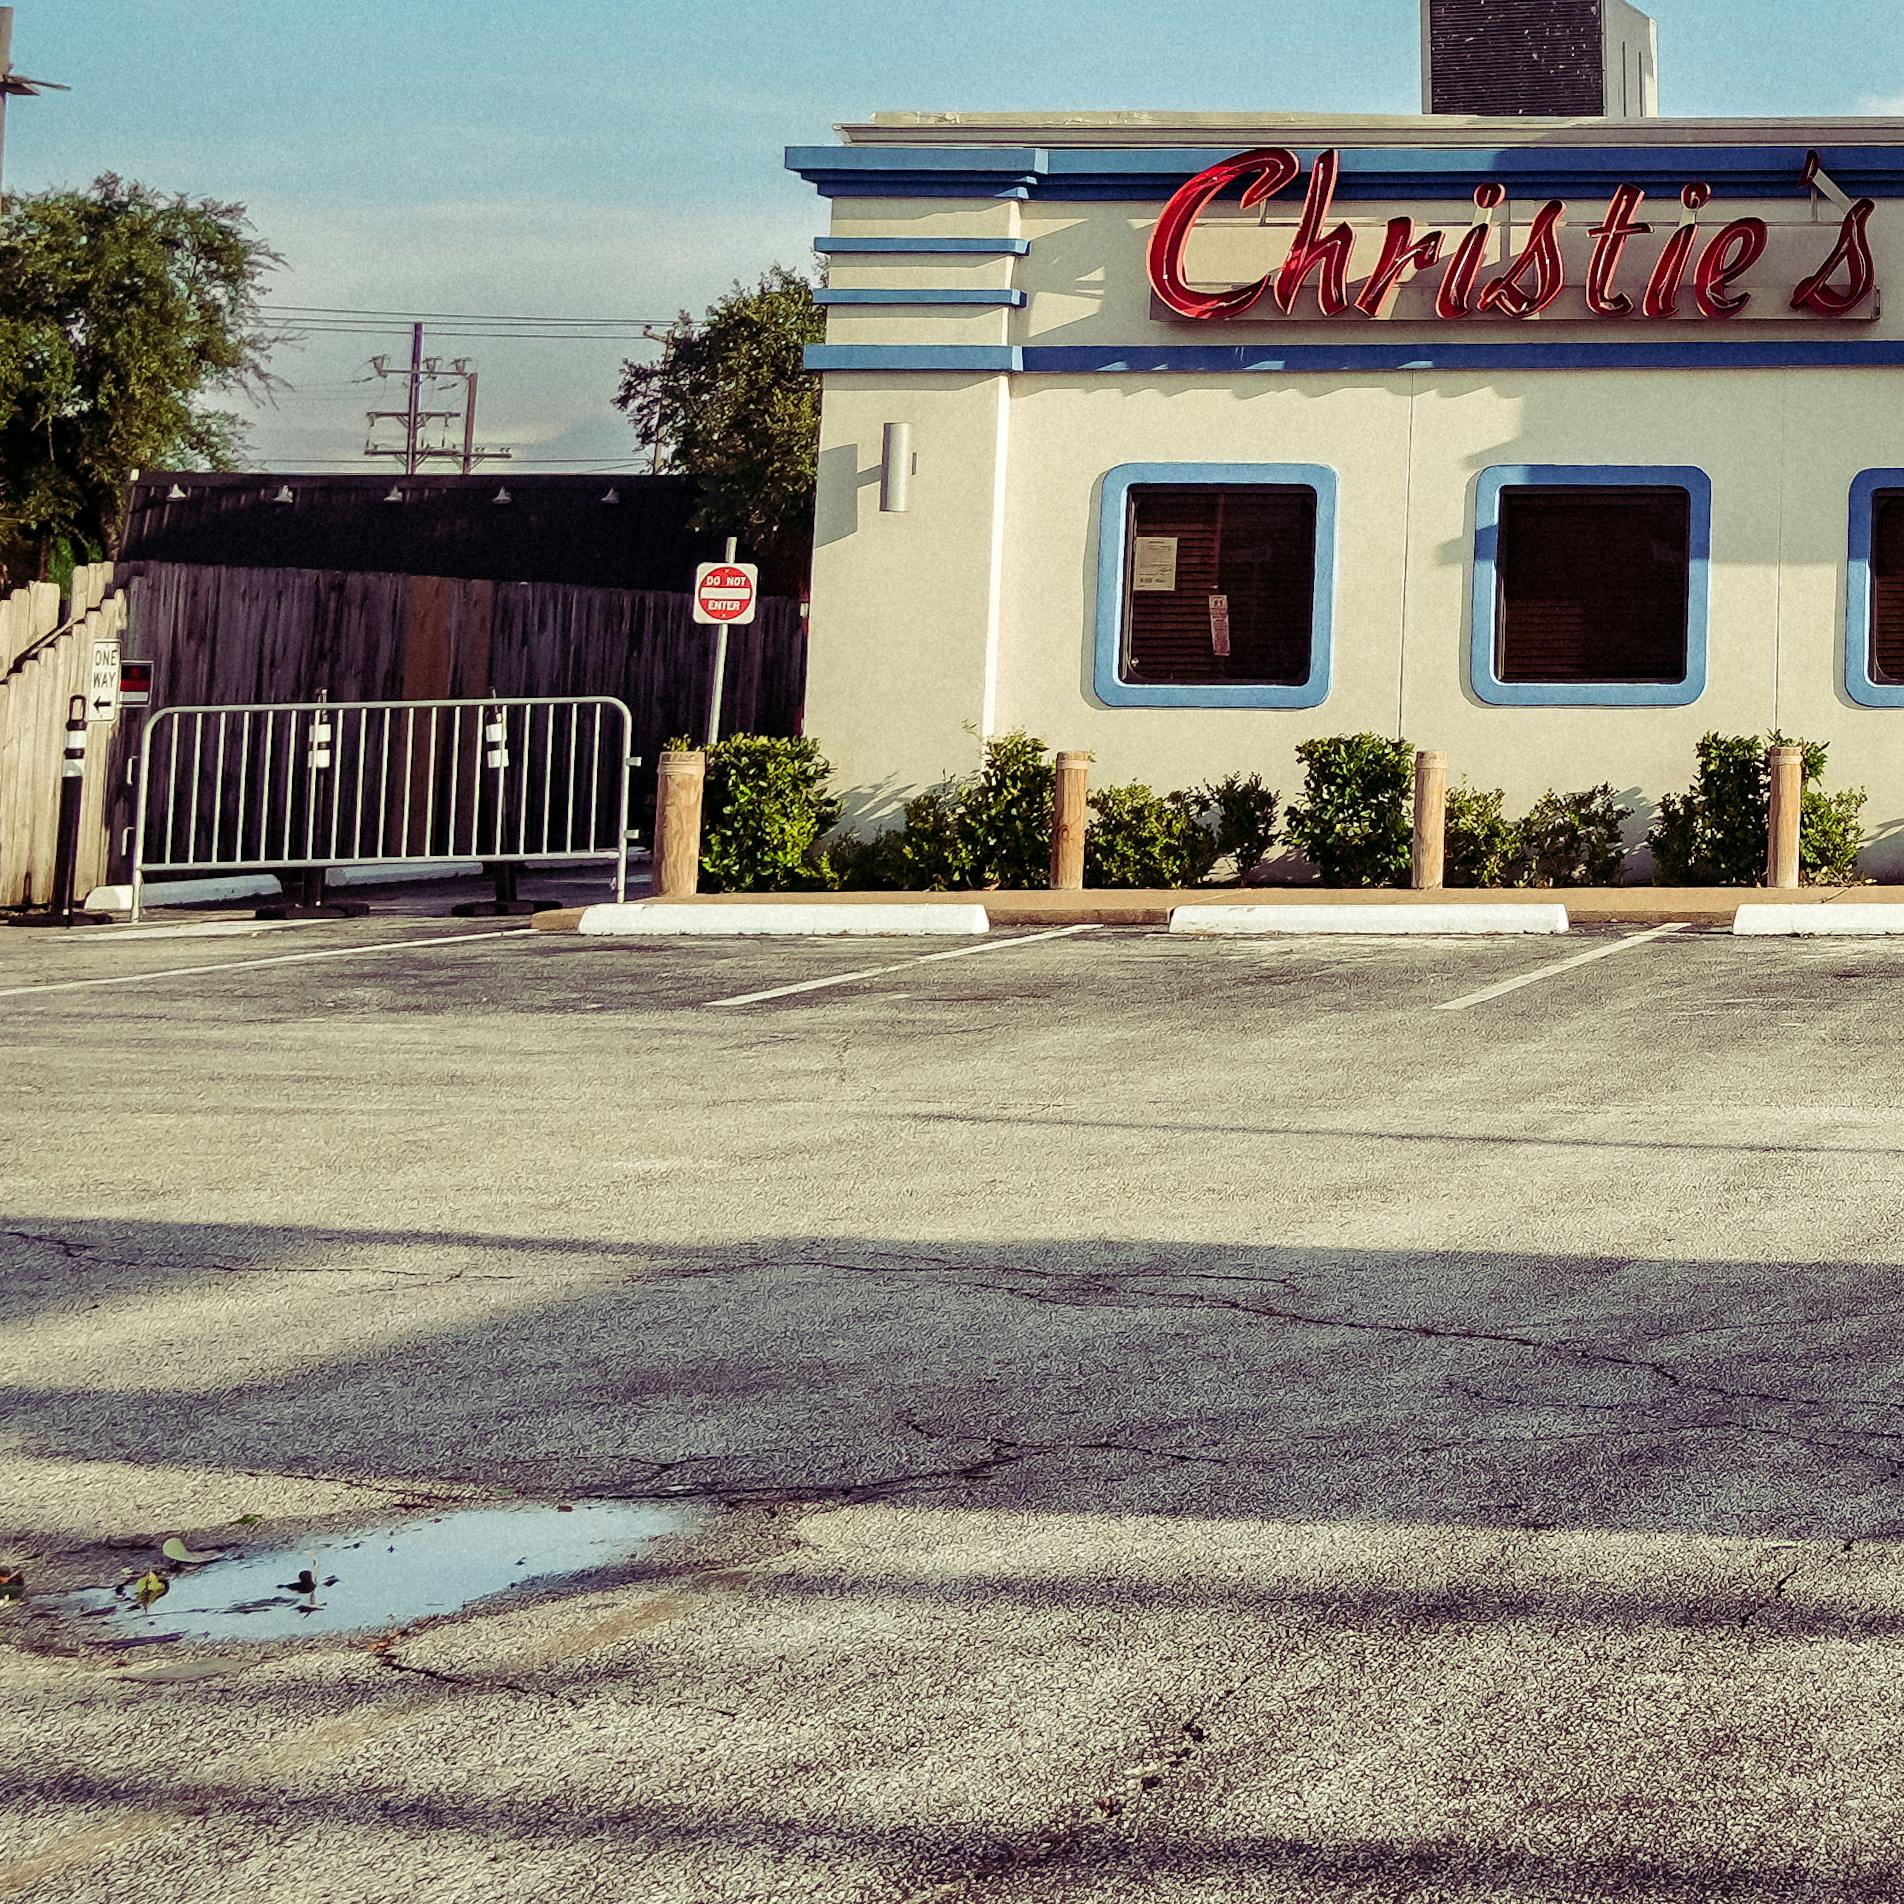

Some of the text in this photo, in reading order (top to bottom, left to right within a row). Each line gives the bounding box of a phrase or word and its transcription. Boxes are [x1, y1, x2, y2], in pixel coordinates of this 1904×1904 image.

[1147, 148, 1876, 319] Christie's
[706, 576, 746, 586] DO NOT
[708, 600, 740, 610] ENTER
[95, 650, 118, 665] ONE
[93, 672, 116, 688] WAY
